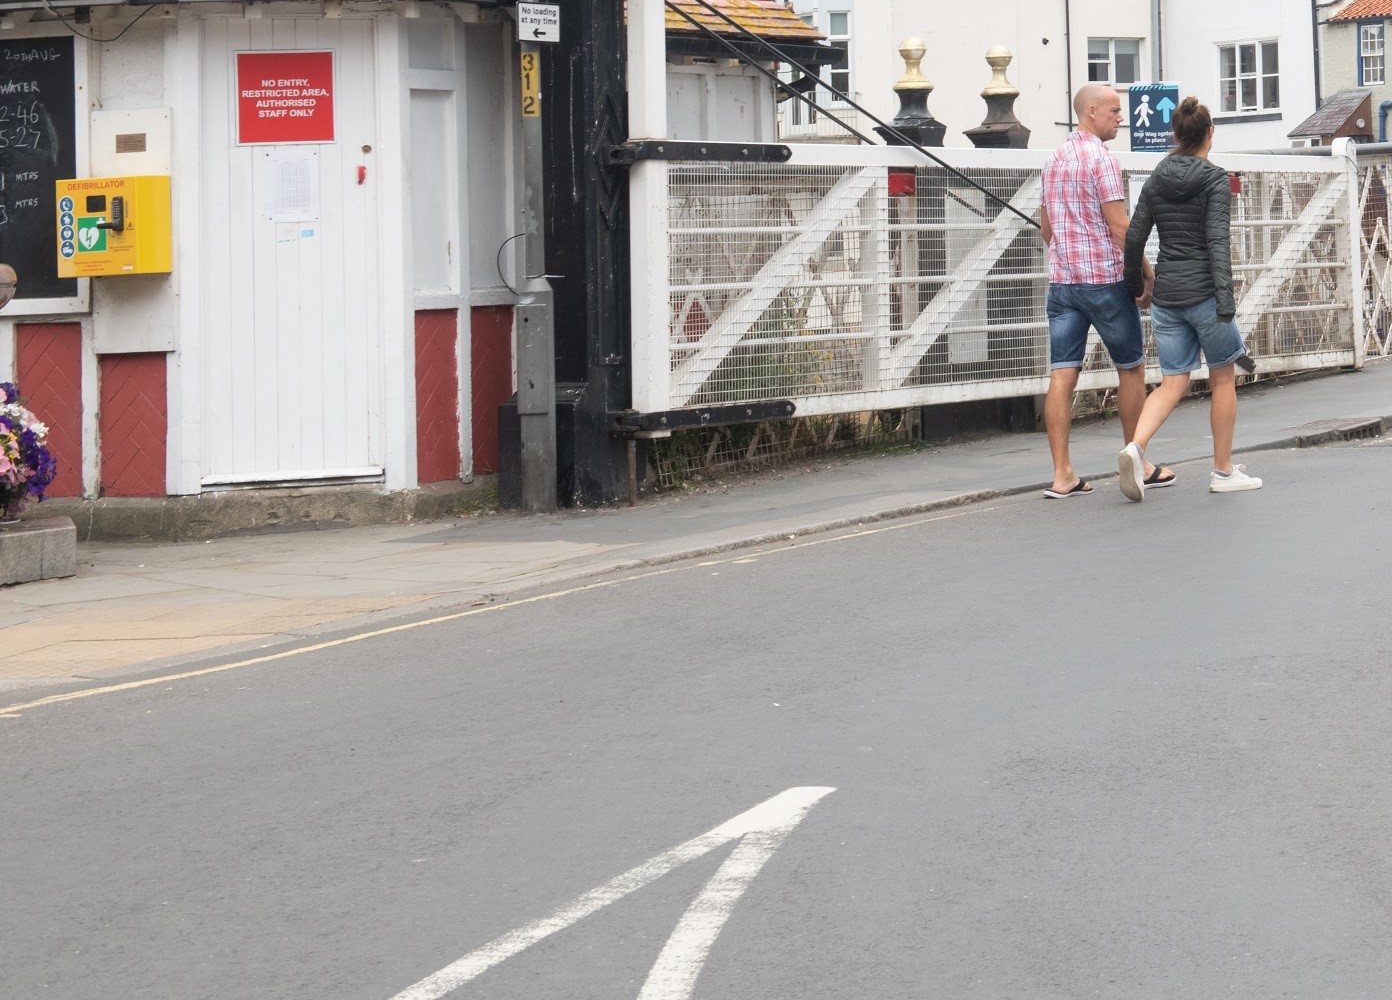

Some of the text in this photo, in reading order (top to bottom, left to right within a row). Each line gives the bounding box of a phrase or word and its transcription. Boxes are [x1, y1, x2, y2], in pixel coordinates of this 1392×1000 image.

[533, 7, 556, 17] loading
[530, 18, 541, 26] any
[277, 78, 310, 87] ENTRY,
[242, 88, 329, 98] RESTRICTED AREA,
[256, 98, 317, 107] AUTHORISED
[258, 109, 314, 118] STAFF ONLY
[67, 180, 126, 191] DEFIBRILLATOR
